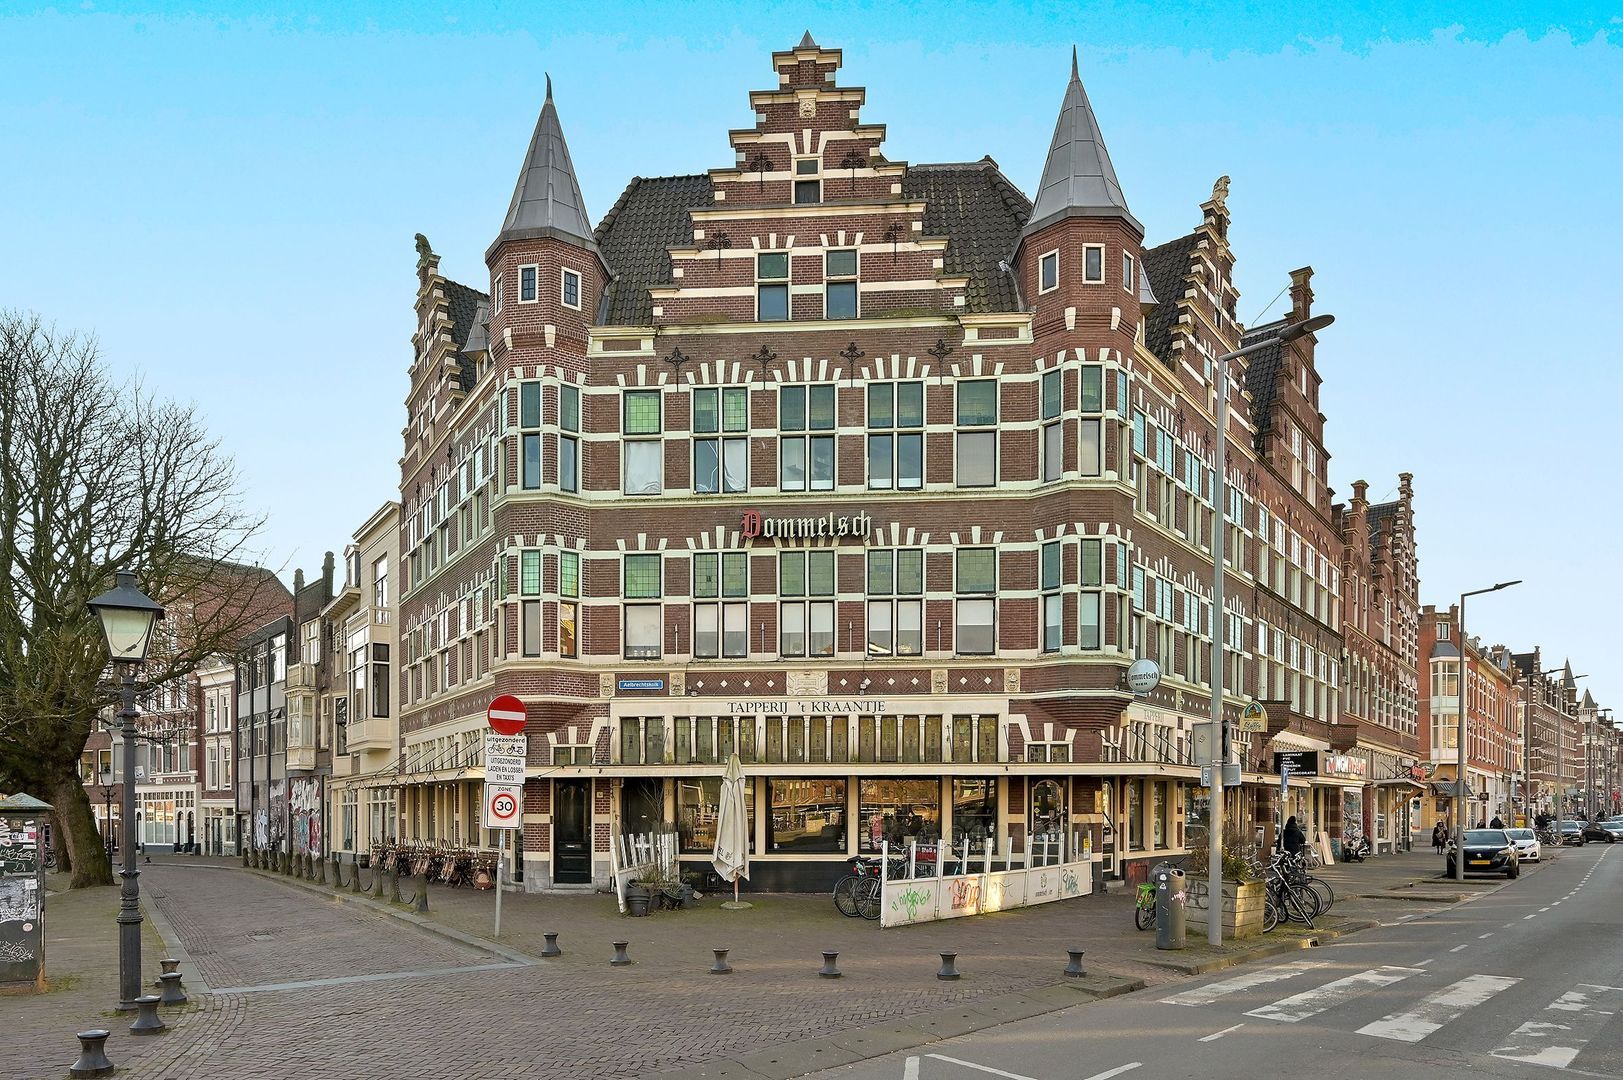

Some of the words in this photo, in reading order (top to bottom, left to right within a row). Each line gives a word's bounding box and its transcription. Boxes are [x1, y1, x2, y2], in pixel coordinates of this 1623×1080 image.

[741, 509, 872, 541] Dommelsch
[727, 701, 788, 714] TAPPERIJ
[811, 701, 886, 713] KRAANTJE
[490, 757, 521, 765] UITGEZONDERD
[496, 801, 512, 811] 30
